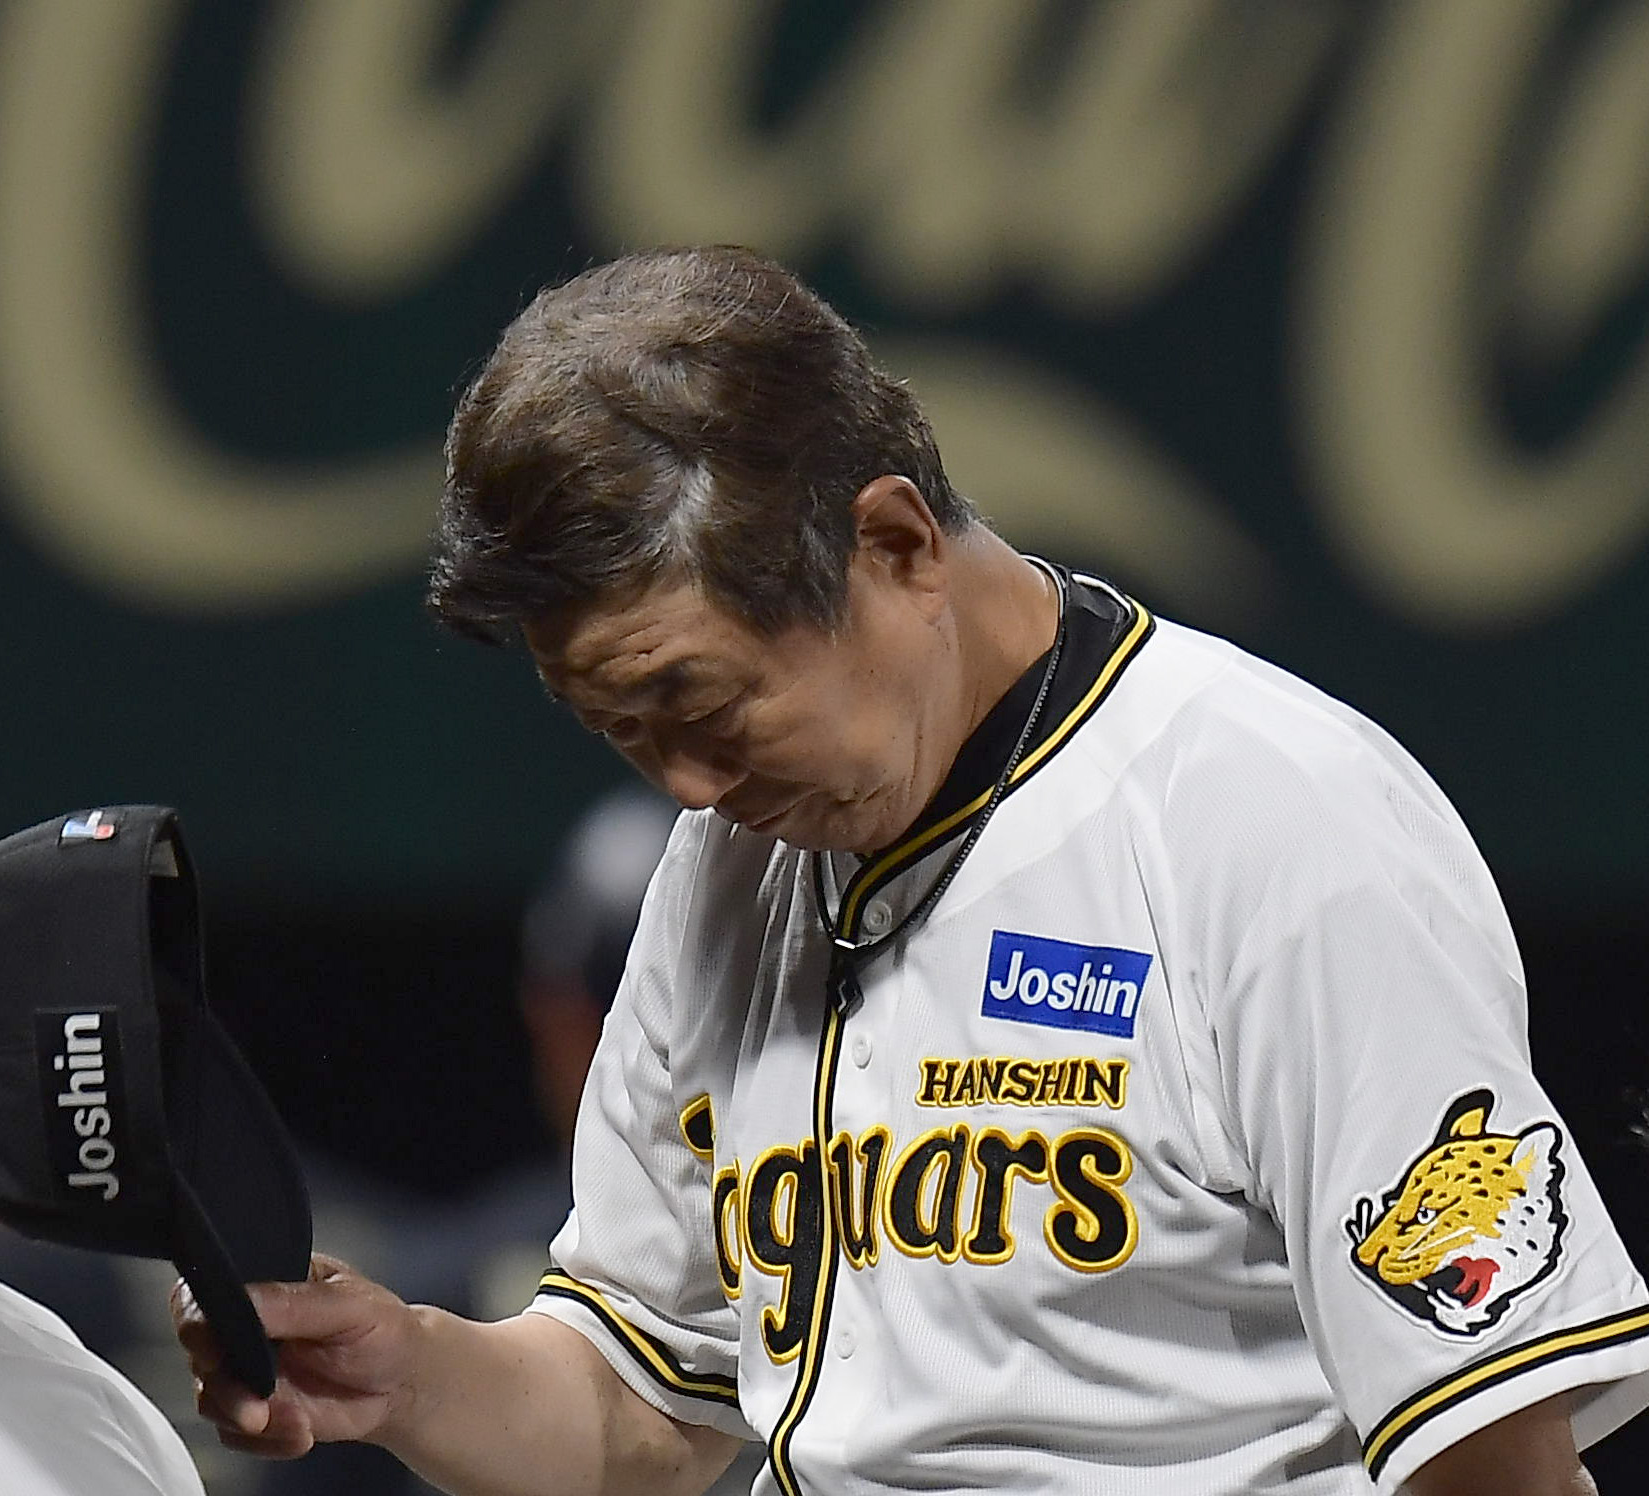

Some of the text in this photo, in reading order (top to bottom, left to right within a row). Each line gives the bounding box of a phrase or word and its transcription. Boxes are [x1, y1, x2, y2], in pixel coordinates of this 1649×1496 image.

[988, 949, 1139, 1019] Joshin
[53, 1011, 120, 1200] Joshin
[914, 1055, 1131, 1109] HANSHIN
